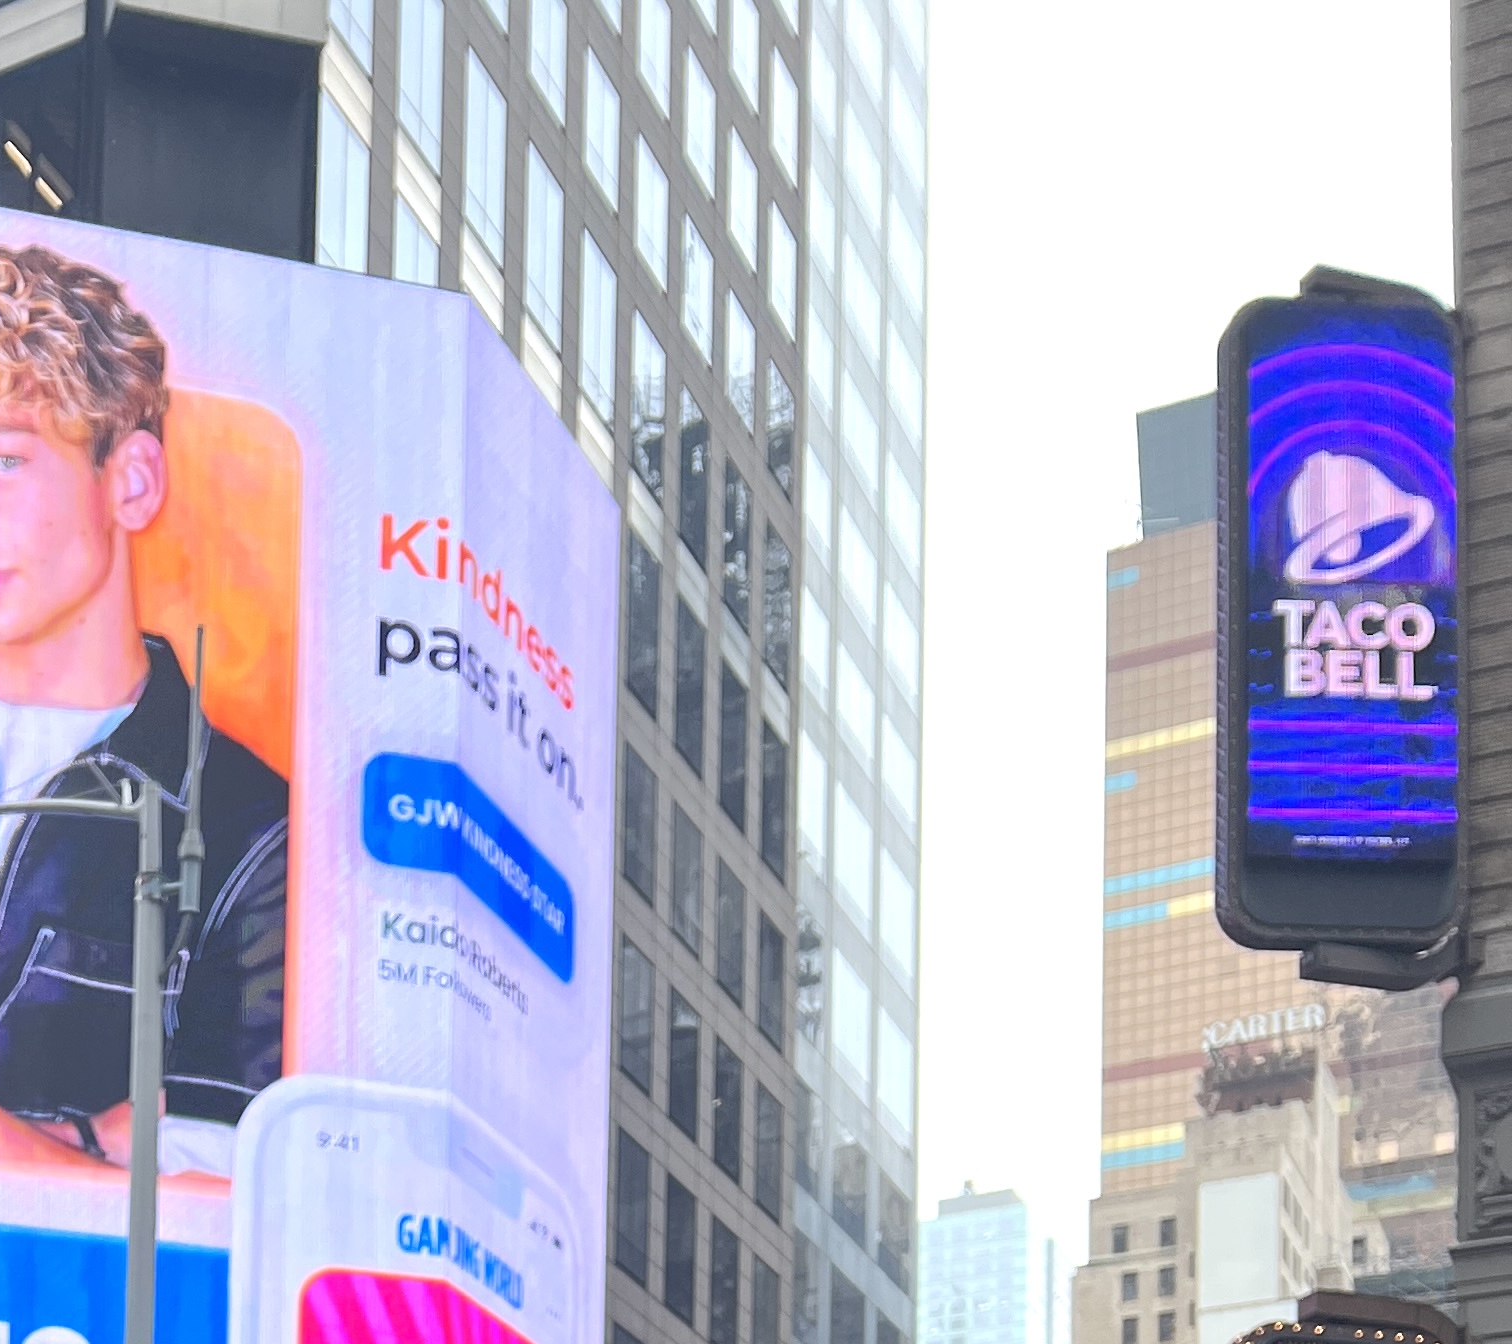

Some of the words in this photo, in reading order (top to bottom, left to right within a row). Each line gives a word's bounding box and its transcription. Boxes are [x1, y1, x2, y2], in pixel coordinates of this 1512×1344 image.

[380, 513, 574, 710] Kindness
[1273, 599, 1435, 650] TACO
[377, 616, 498, 711] pass
[506, 671, 530, 750] it
[1285, 649, 1439, 699] BELL
[389, 794, 460, 830] GJW
